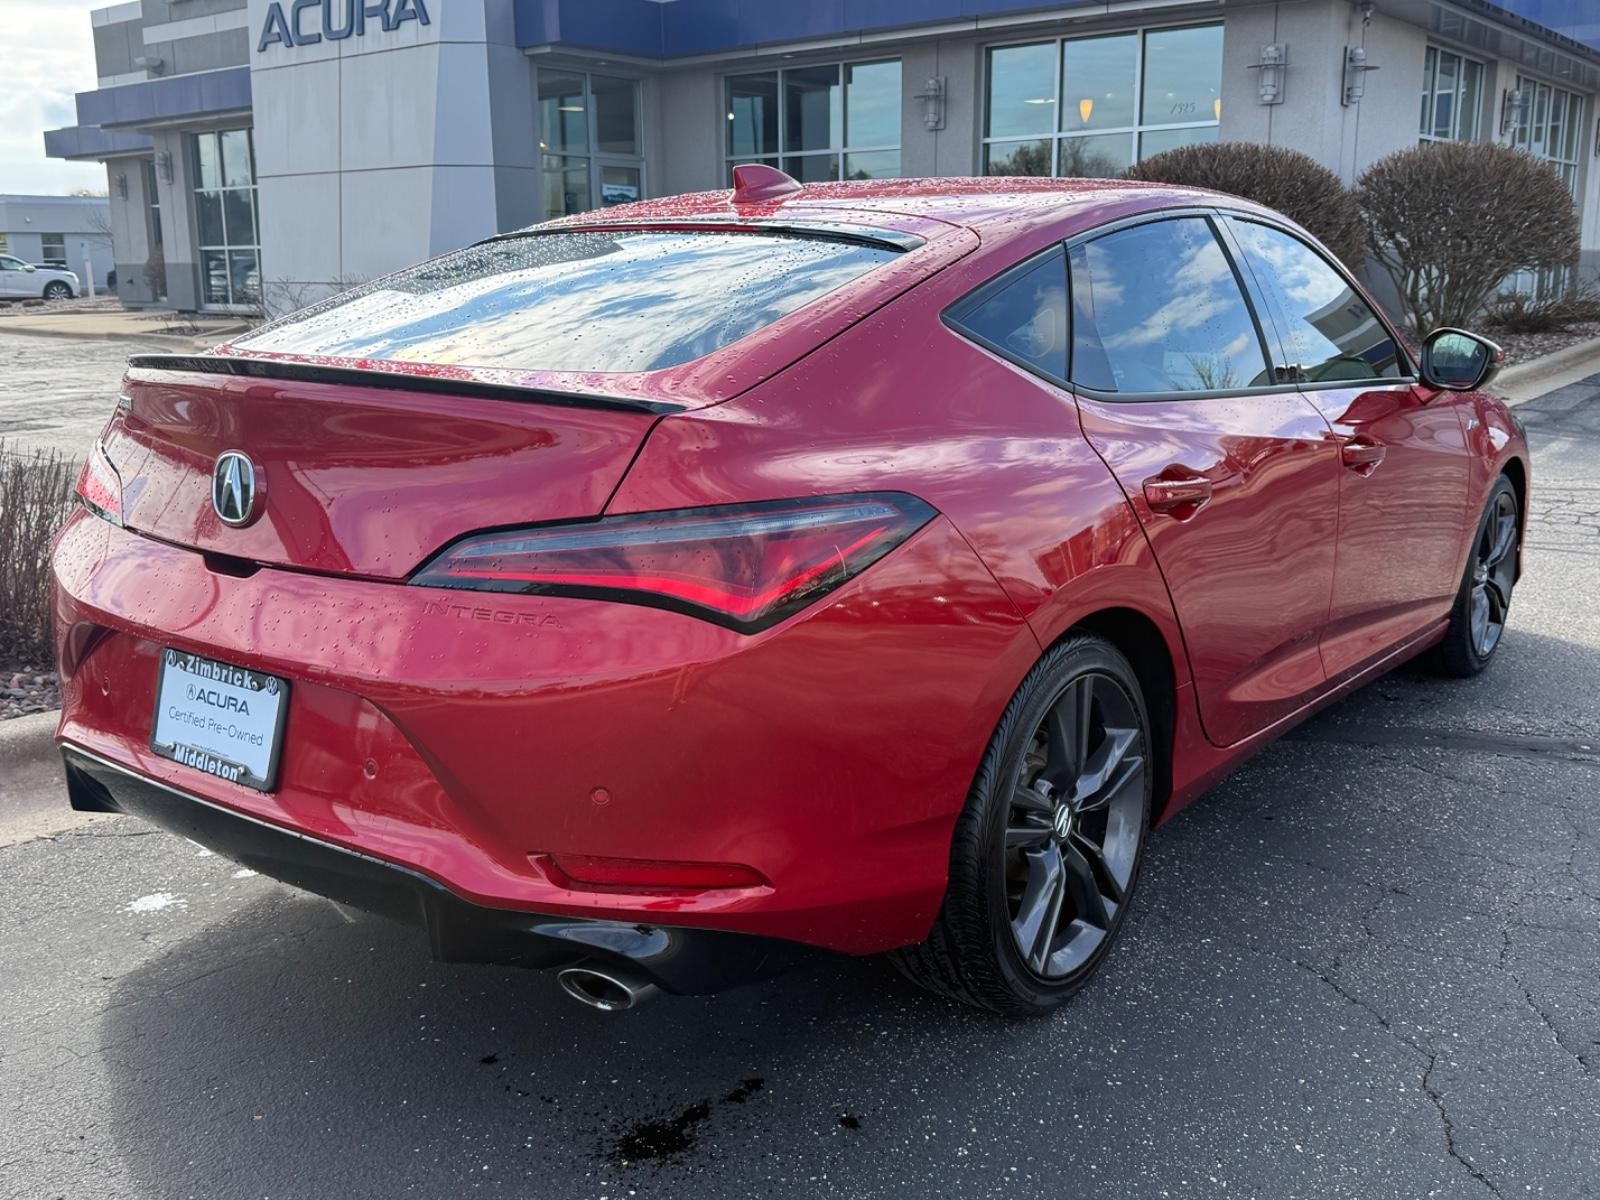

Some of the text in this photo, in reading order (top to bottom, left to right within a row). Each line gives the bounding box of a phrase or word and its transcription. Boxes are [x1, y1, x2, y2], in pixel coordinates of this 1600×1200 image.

[257, 0, 431, 52] ACURA
[422, 602, 564, 629] INTEGRA
[186, 655, 253, 690] Zimbrick
[195, 688, 250, 716] ACURA
[168, 706, 264, 746] Certified Pre-Owned
[174, 744, 239, 782] Middleton
